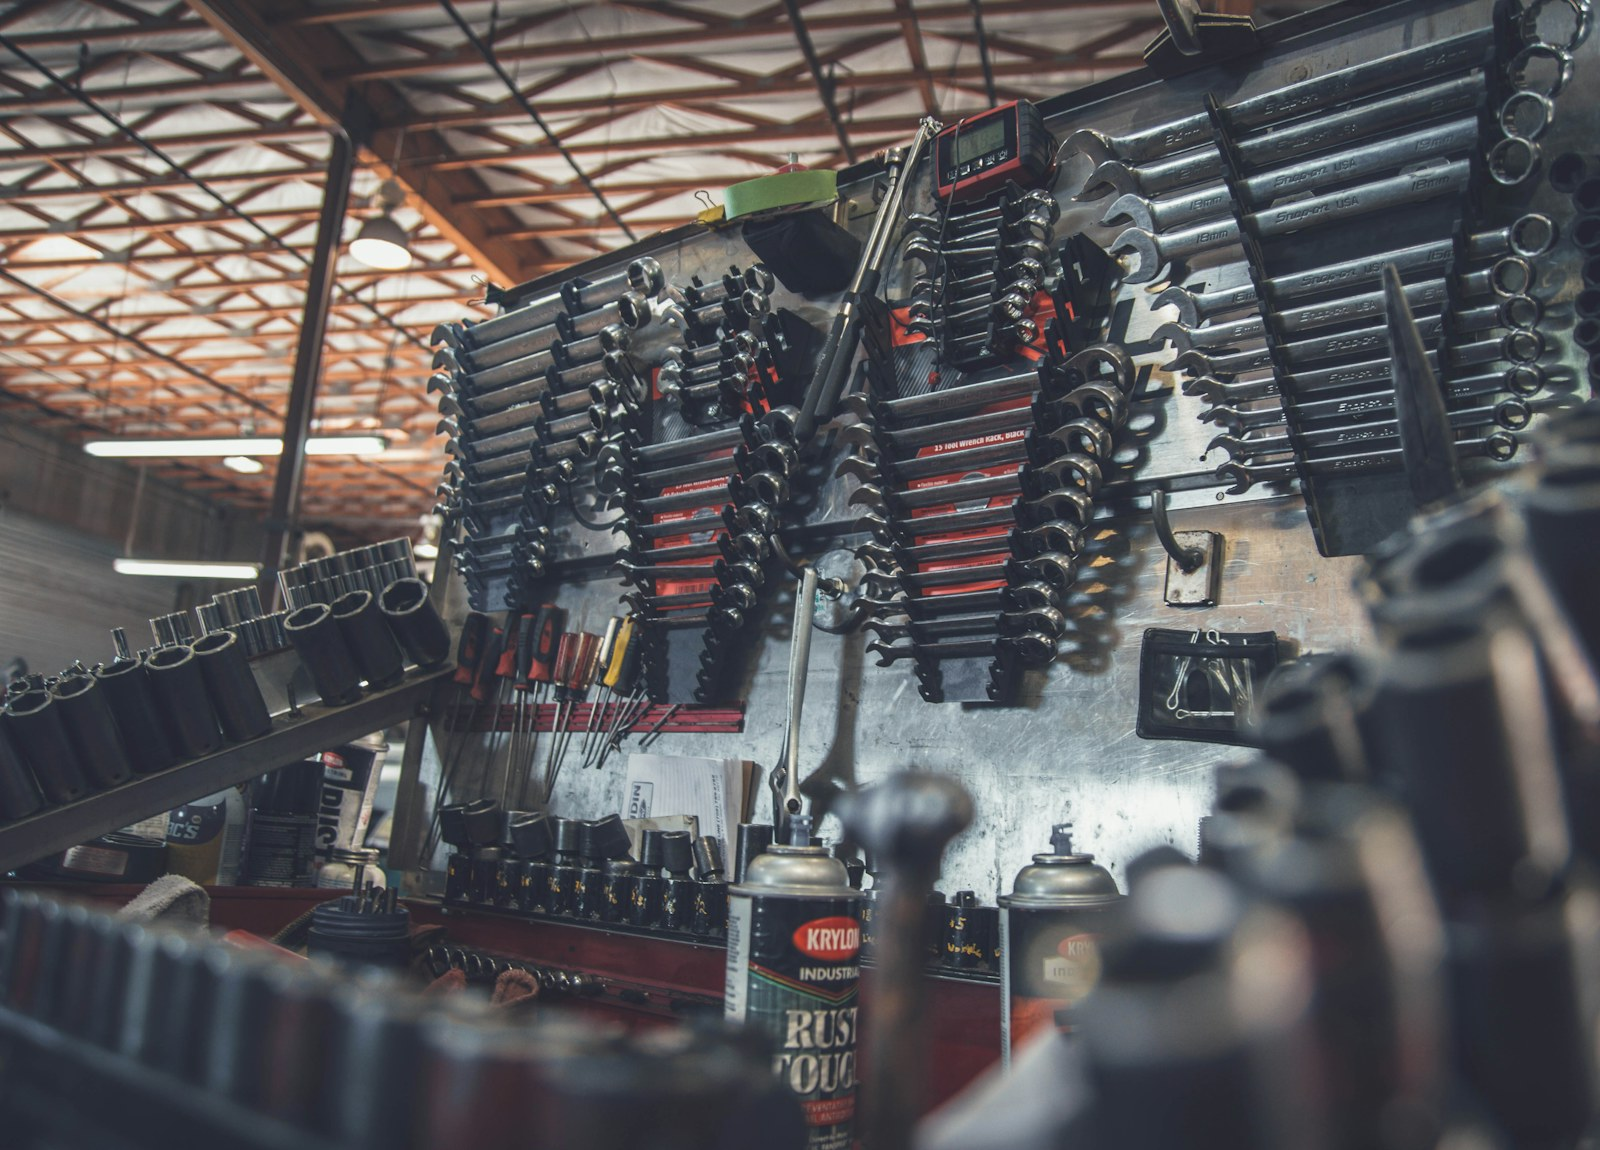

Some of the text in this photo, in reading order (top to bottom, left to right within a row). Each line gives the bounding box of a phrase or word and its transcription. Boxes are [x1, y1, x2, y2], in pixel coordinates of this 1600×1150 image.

[1274, 158, 1357, 188] Snap-on USA
[1411, 174, 1450, 192] 18mm
[1275, 195, 1360, 225] Snap-on USA
[1196, 230, 1228, 244] 18mm
[1301, 269, 1357, 287] Snap-on
[1299, 300, 1377, 323] Snap-on USA
[772, 1050, 860, 1095] TOUG
